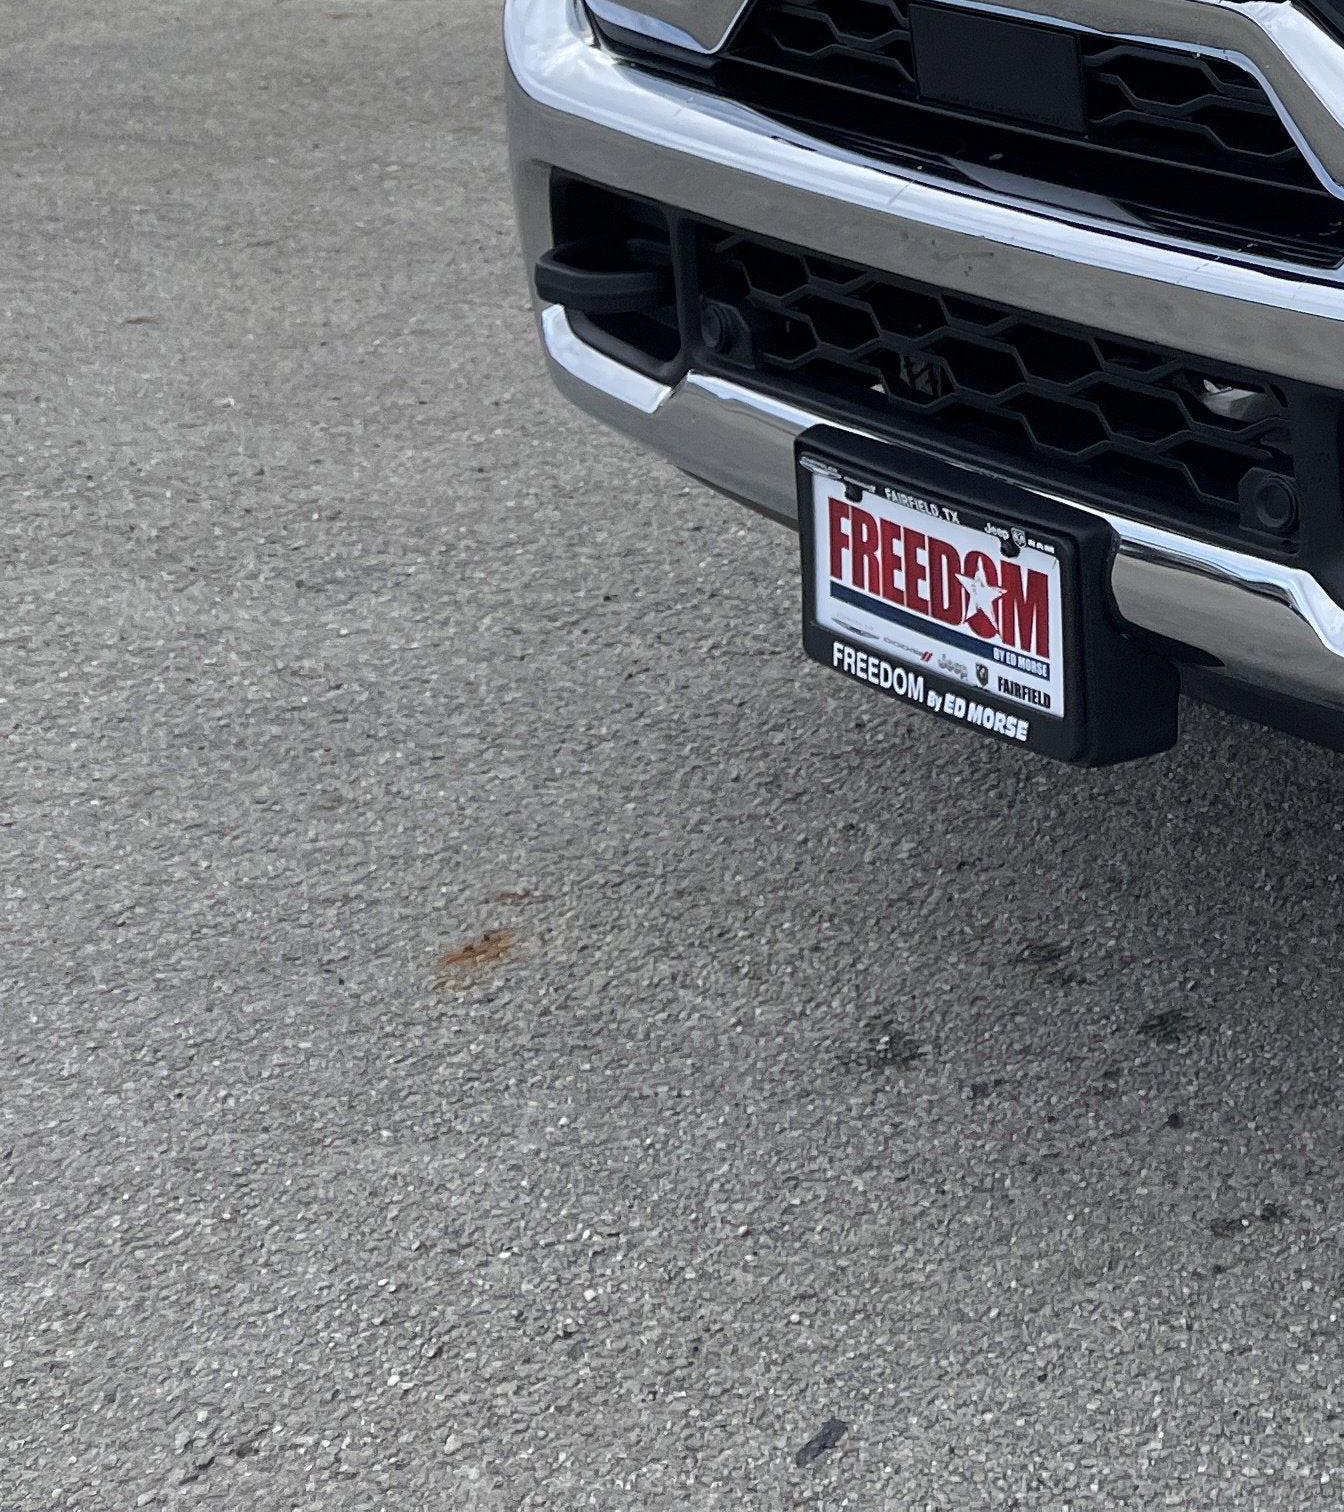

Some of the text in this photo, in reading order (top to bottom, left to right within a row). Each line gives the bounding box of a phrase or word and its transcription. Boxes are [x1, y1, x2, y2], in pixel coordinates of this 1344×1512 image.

[828, 496, 1050, 660] FREEDOM
[832, 640, 925, 703] FREEDOM
[943, 693, 967, 719] ED
[967, 701, 1030, 742] MORSE
[993, 646, 1049, 679] BY ED MORSE
[997, 676, 1051, 709] FAIRFIELD
